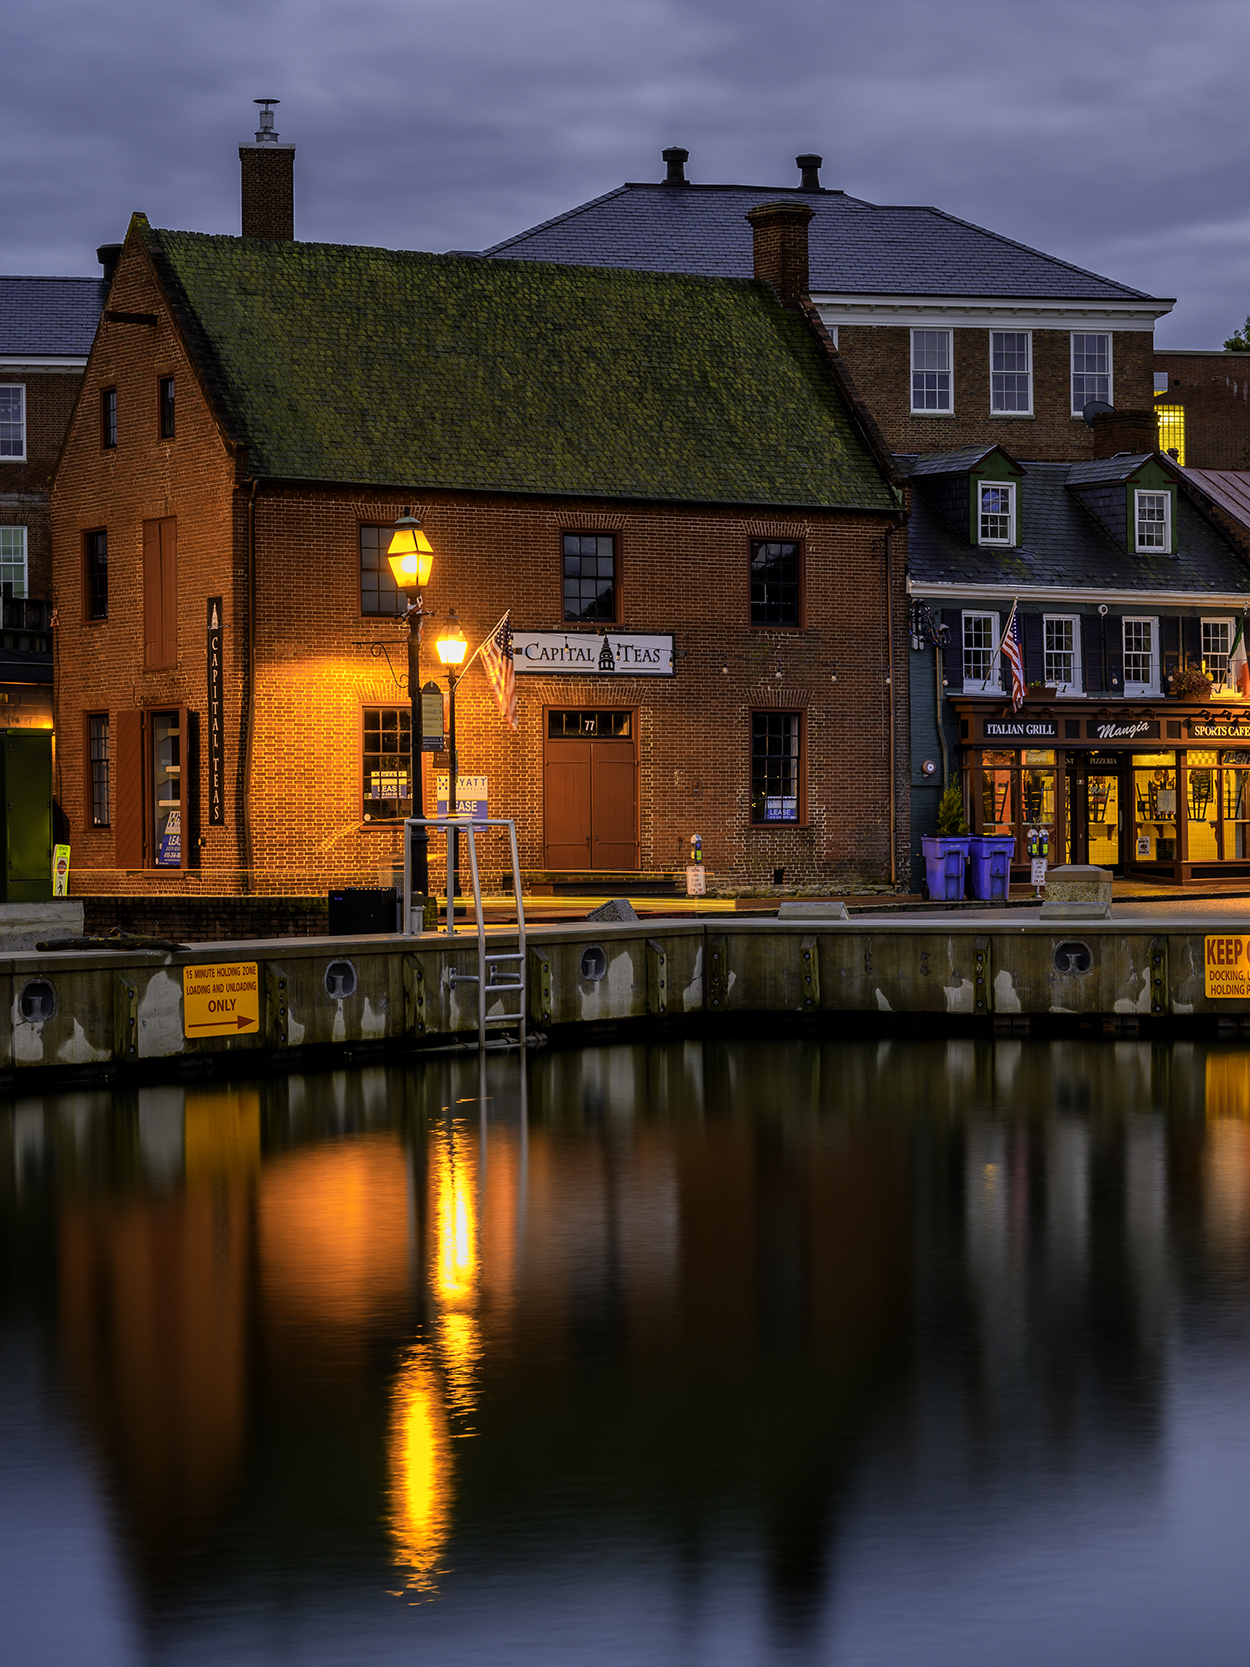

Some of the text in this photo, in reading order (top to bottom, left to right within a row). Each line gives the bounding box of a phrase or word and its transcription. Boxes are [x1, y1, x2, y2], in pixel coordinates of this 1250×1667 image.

[525, 642, 660, 663] CAPITAL TEAS
[211, 636, 219, 748] CAPITAL
[584, 720, 595, 730] 77
[987, 724, 1055, 735] ITALIAN GRILL
[1097, 721, 1150, 738] Mangia
[1194, 726, 1227, 736] SPORTS
[1207, 939, 1243, 965] KEEP
[186, 966, 256, 979] 15 MINUTE HOLDING ZONE
[1210, 970, 1245, 982] DOCKING,
[187, 981, 256, 995] LOADING AND UNLOADING
[1211, 985, 1245, 994] HOLDING
[208, 999, 236, 1012] ONLY
